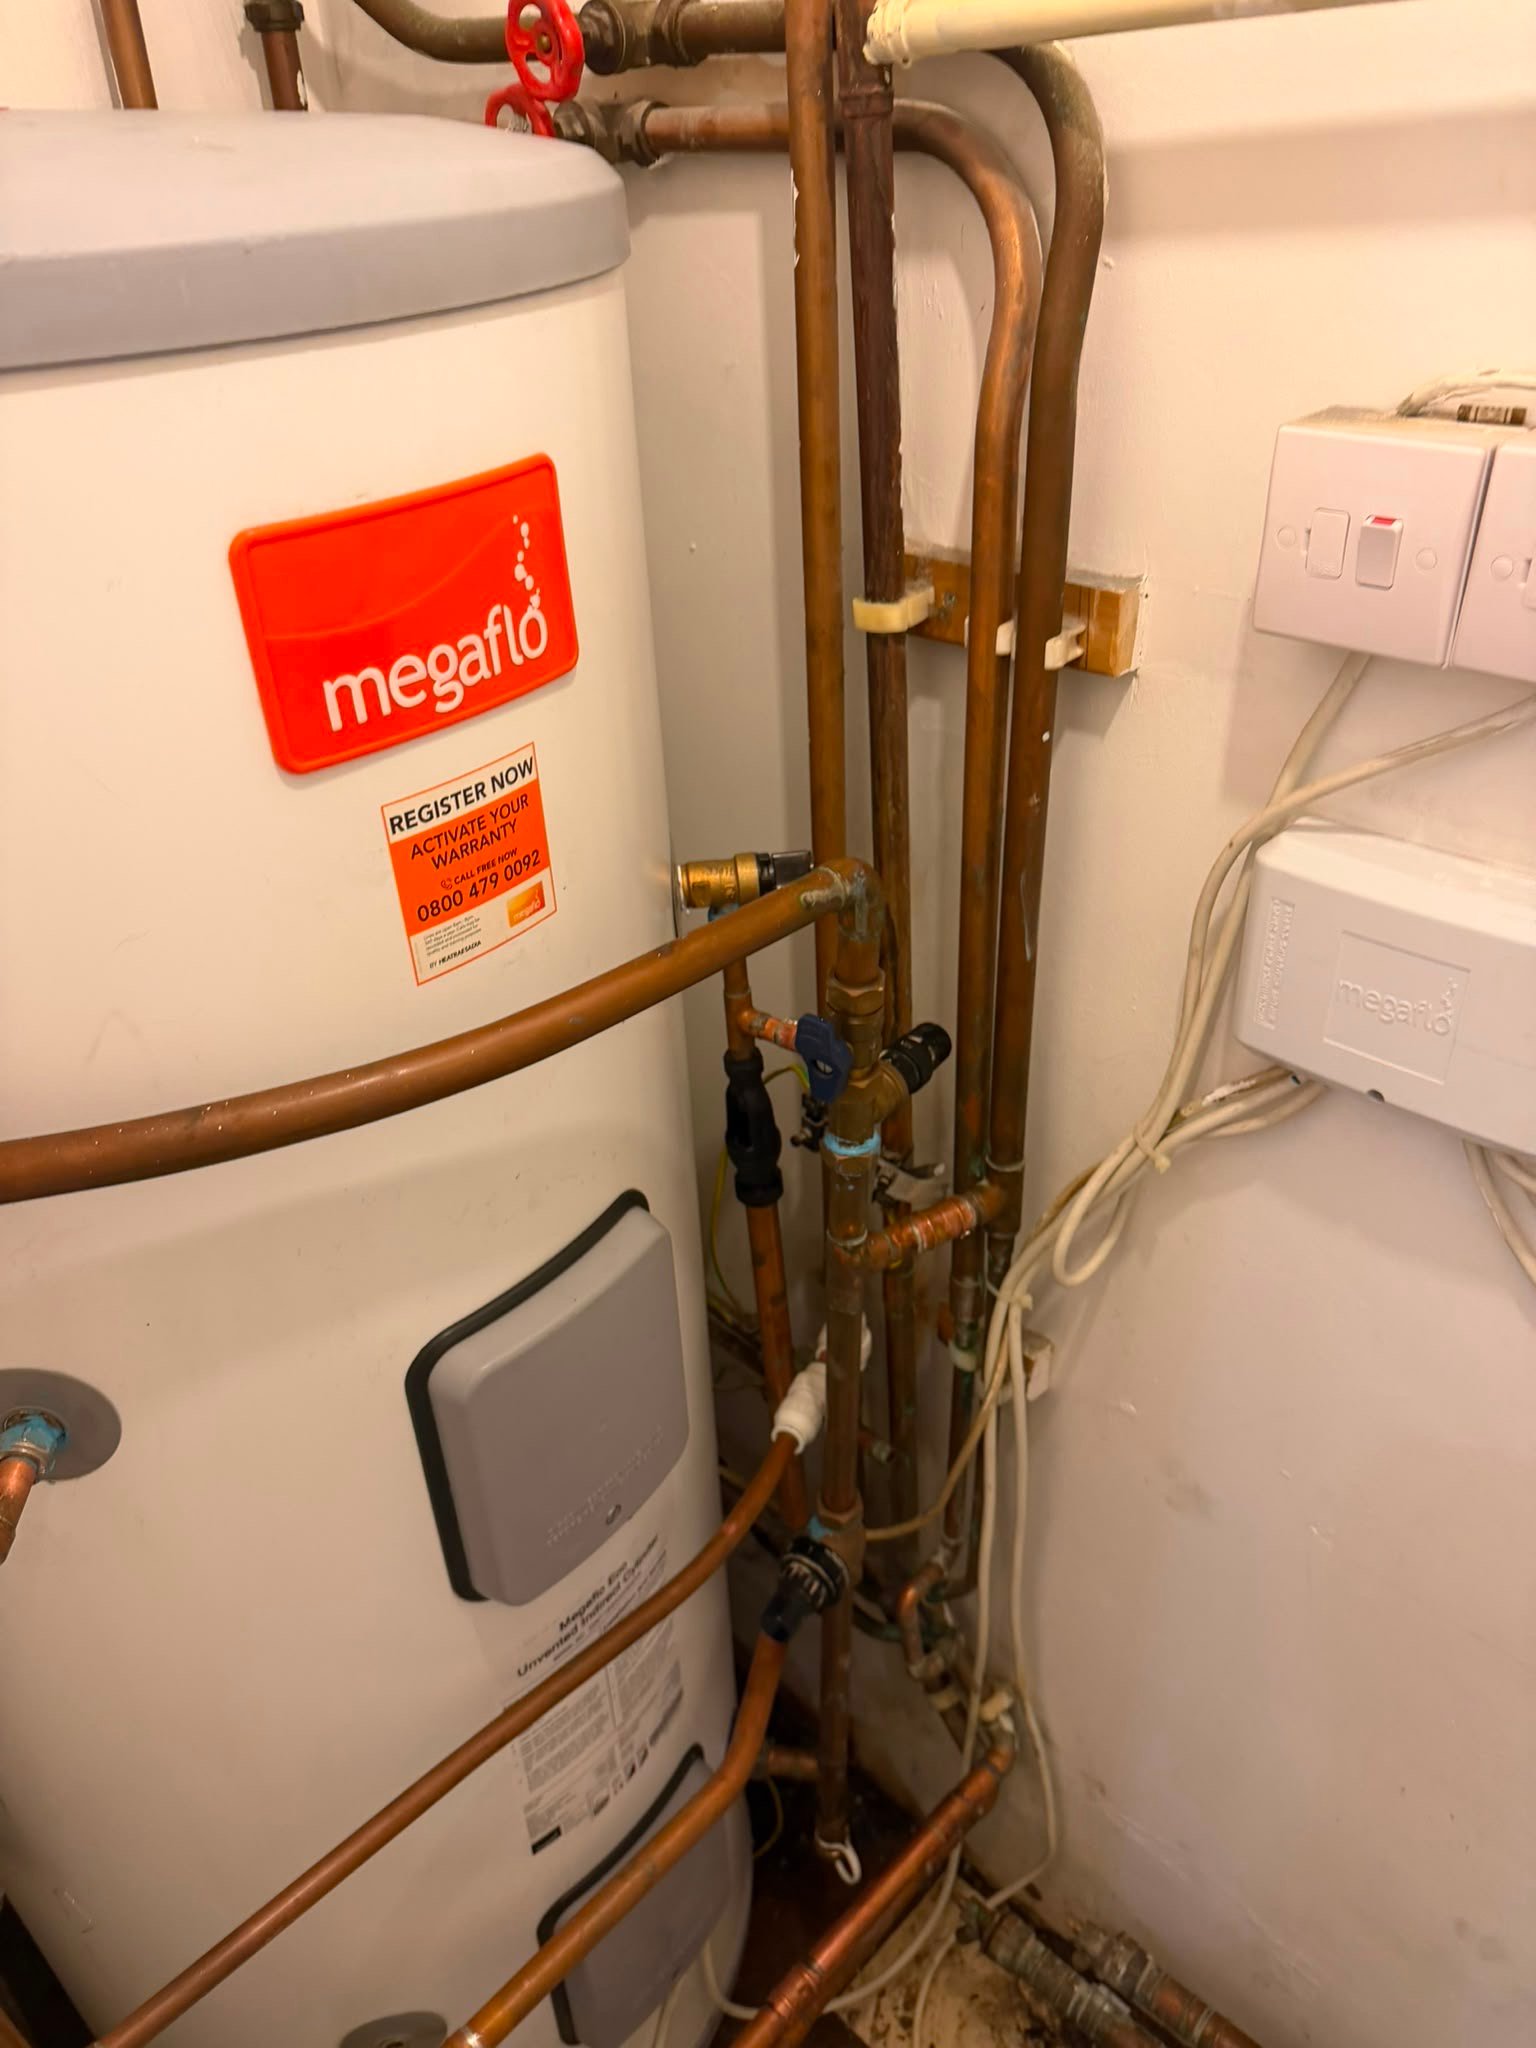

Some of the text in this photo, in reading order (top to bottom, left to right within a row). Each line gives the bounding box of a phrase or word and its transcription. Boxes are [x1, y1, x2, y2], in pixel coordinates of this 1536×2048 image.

[322, 603, 548, 732] megaflo
[389, 756, 534, 835] REGISTER NOW
[410, 793, 529, 860] ACTIVATE YOUR
[431, 818, 517, 870] WARRANTY
[453, 848, 518, 885] CALL FREE NOW
[417, 849, 541, 922] 0800 479 0092
[517, 1624, 578, 1677] Unvented
